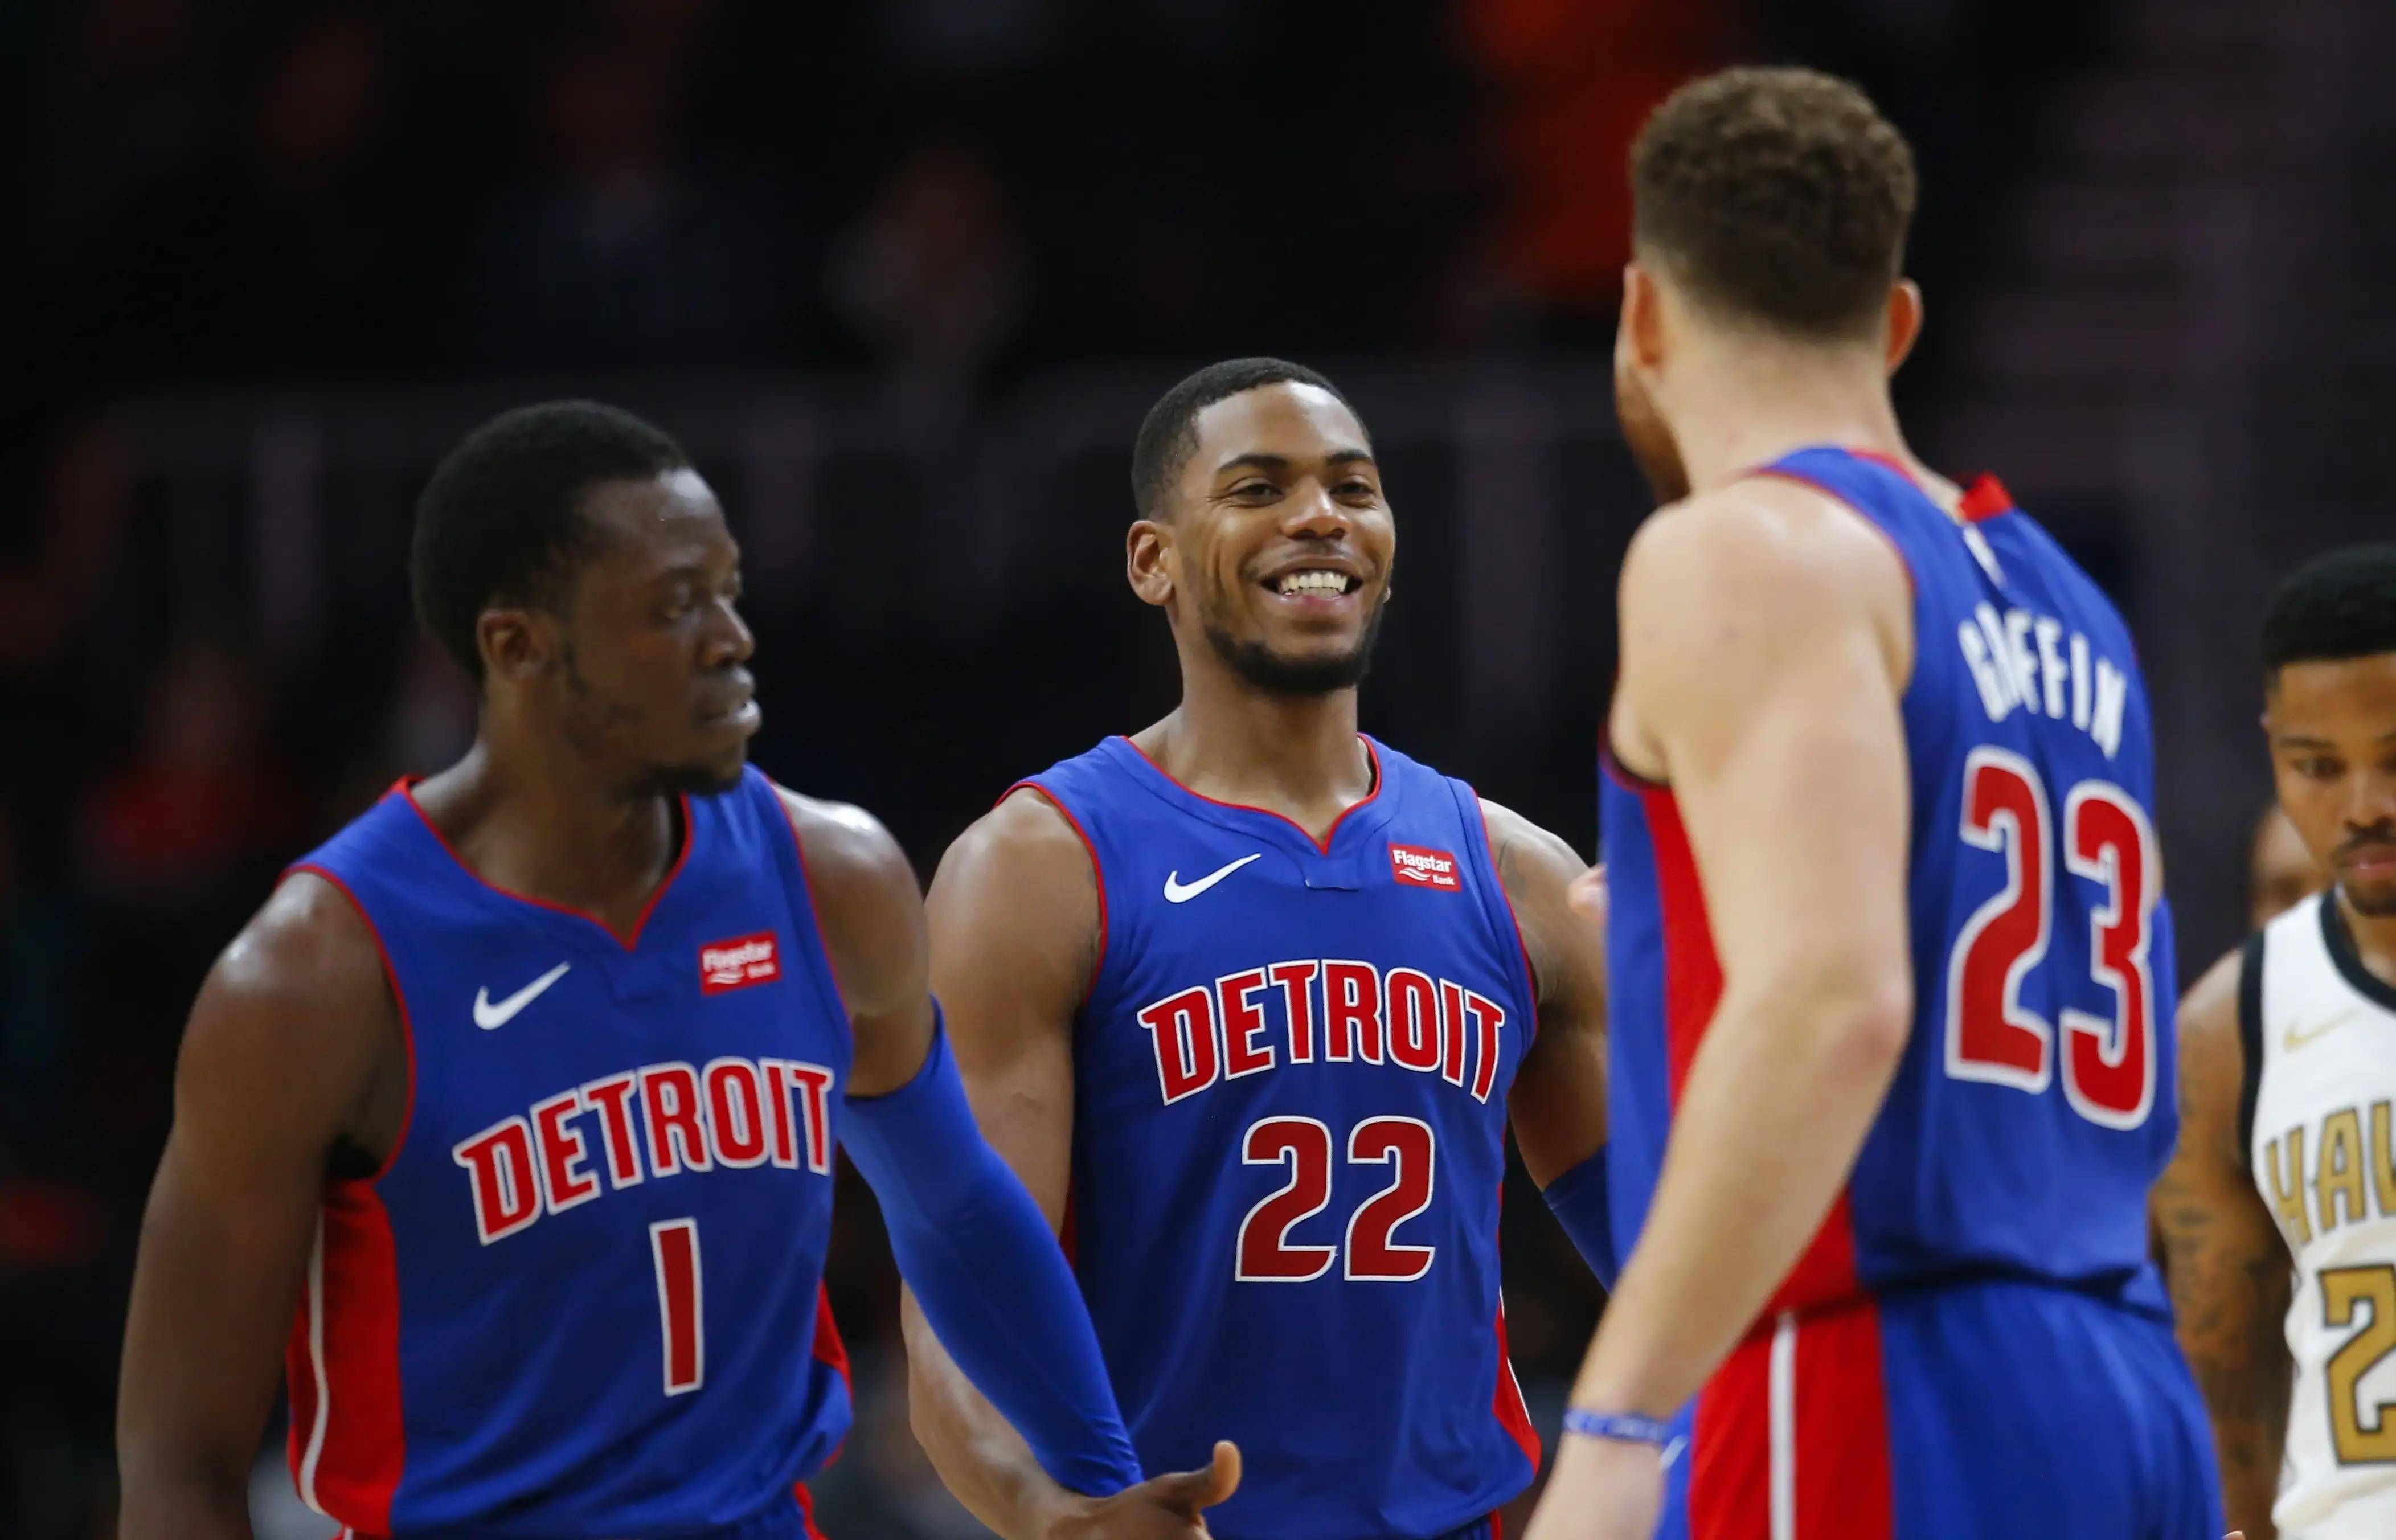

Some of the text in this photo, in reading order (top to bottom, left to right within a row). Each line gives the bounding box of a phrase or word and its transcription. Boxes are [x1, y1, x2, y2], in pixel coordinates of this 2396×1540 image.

[1392, 849, 1451, 873] Flagstar
[1432, 874, 1455, 885] Bank
[1944, 745, 2157, 1131] 23
[1137, 959, 1505, 1106] DETROIT
[453, 1056, 834, 1246] DETROIT
[1234, 1116, 1435, 1282] 22
[649, 1218, 704, 1396] 1
[2317, 1263, 2396, 1466] 2
